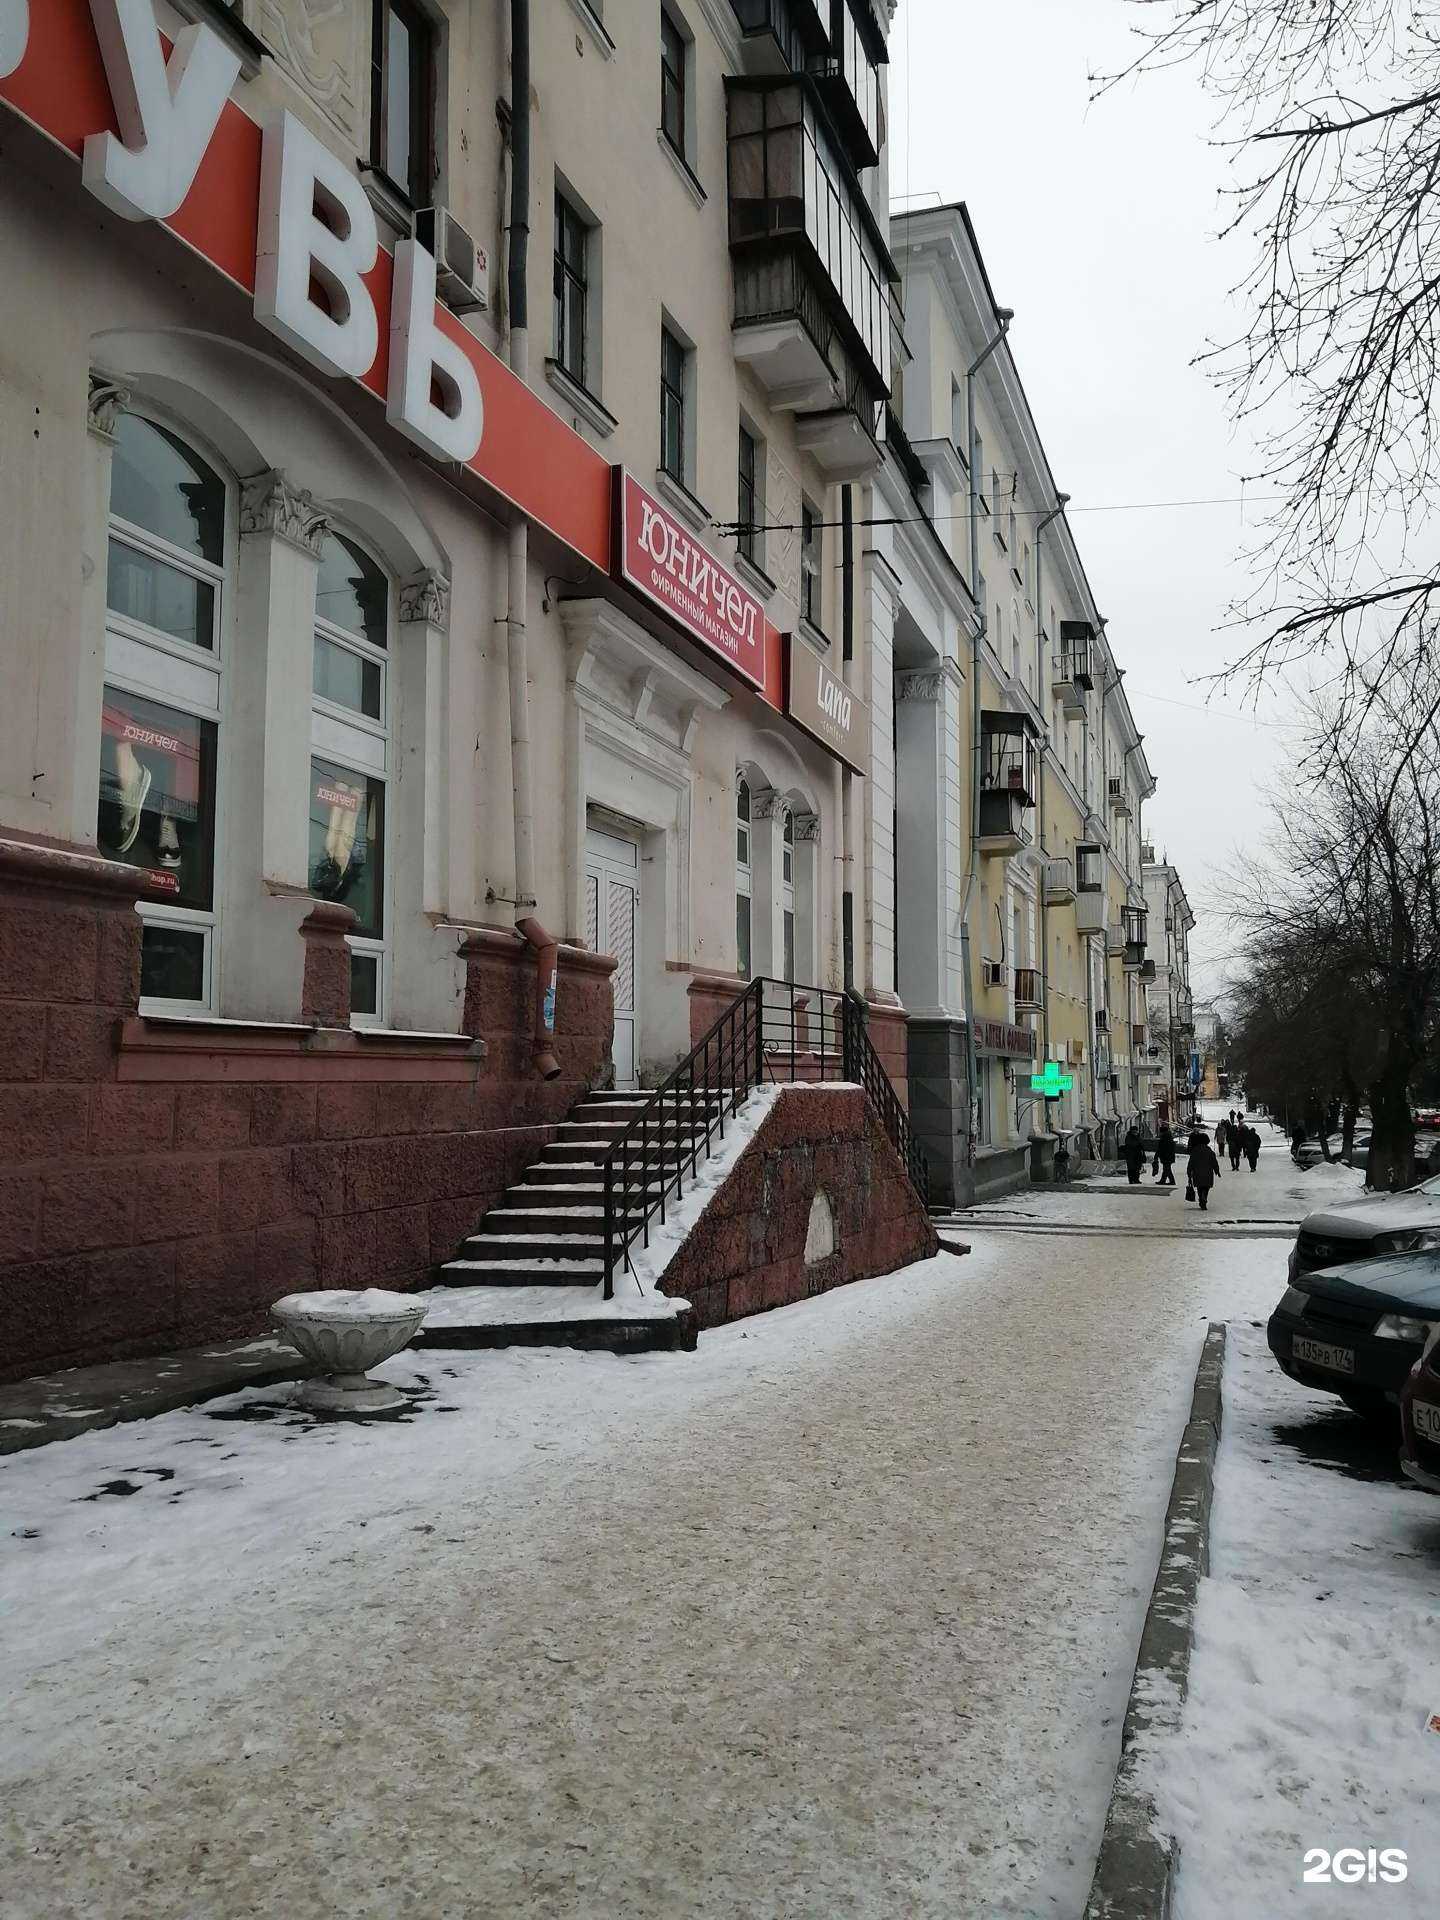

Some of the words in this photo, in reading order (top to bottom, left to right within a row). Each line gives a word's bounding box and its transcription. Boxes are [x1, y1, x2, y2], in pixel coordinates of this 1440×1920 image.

[651, 569, 705, 625] ФИРМЕННЫЙ
[705, 618, 739, 655] МАГАЗИН
[817, 664, 852, 732] Lana
[150, 872, 175, 885] hop.ru
